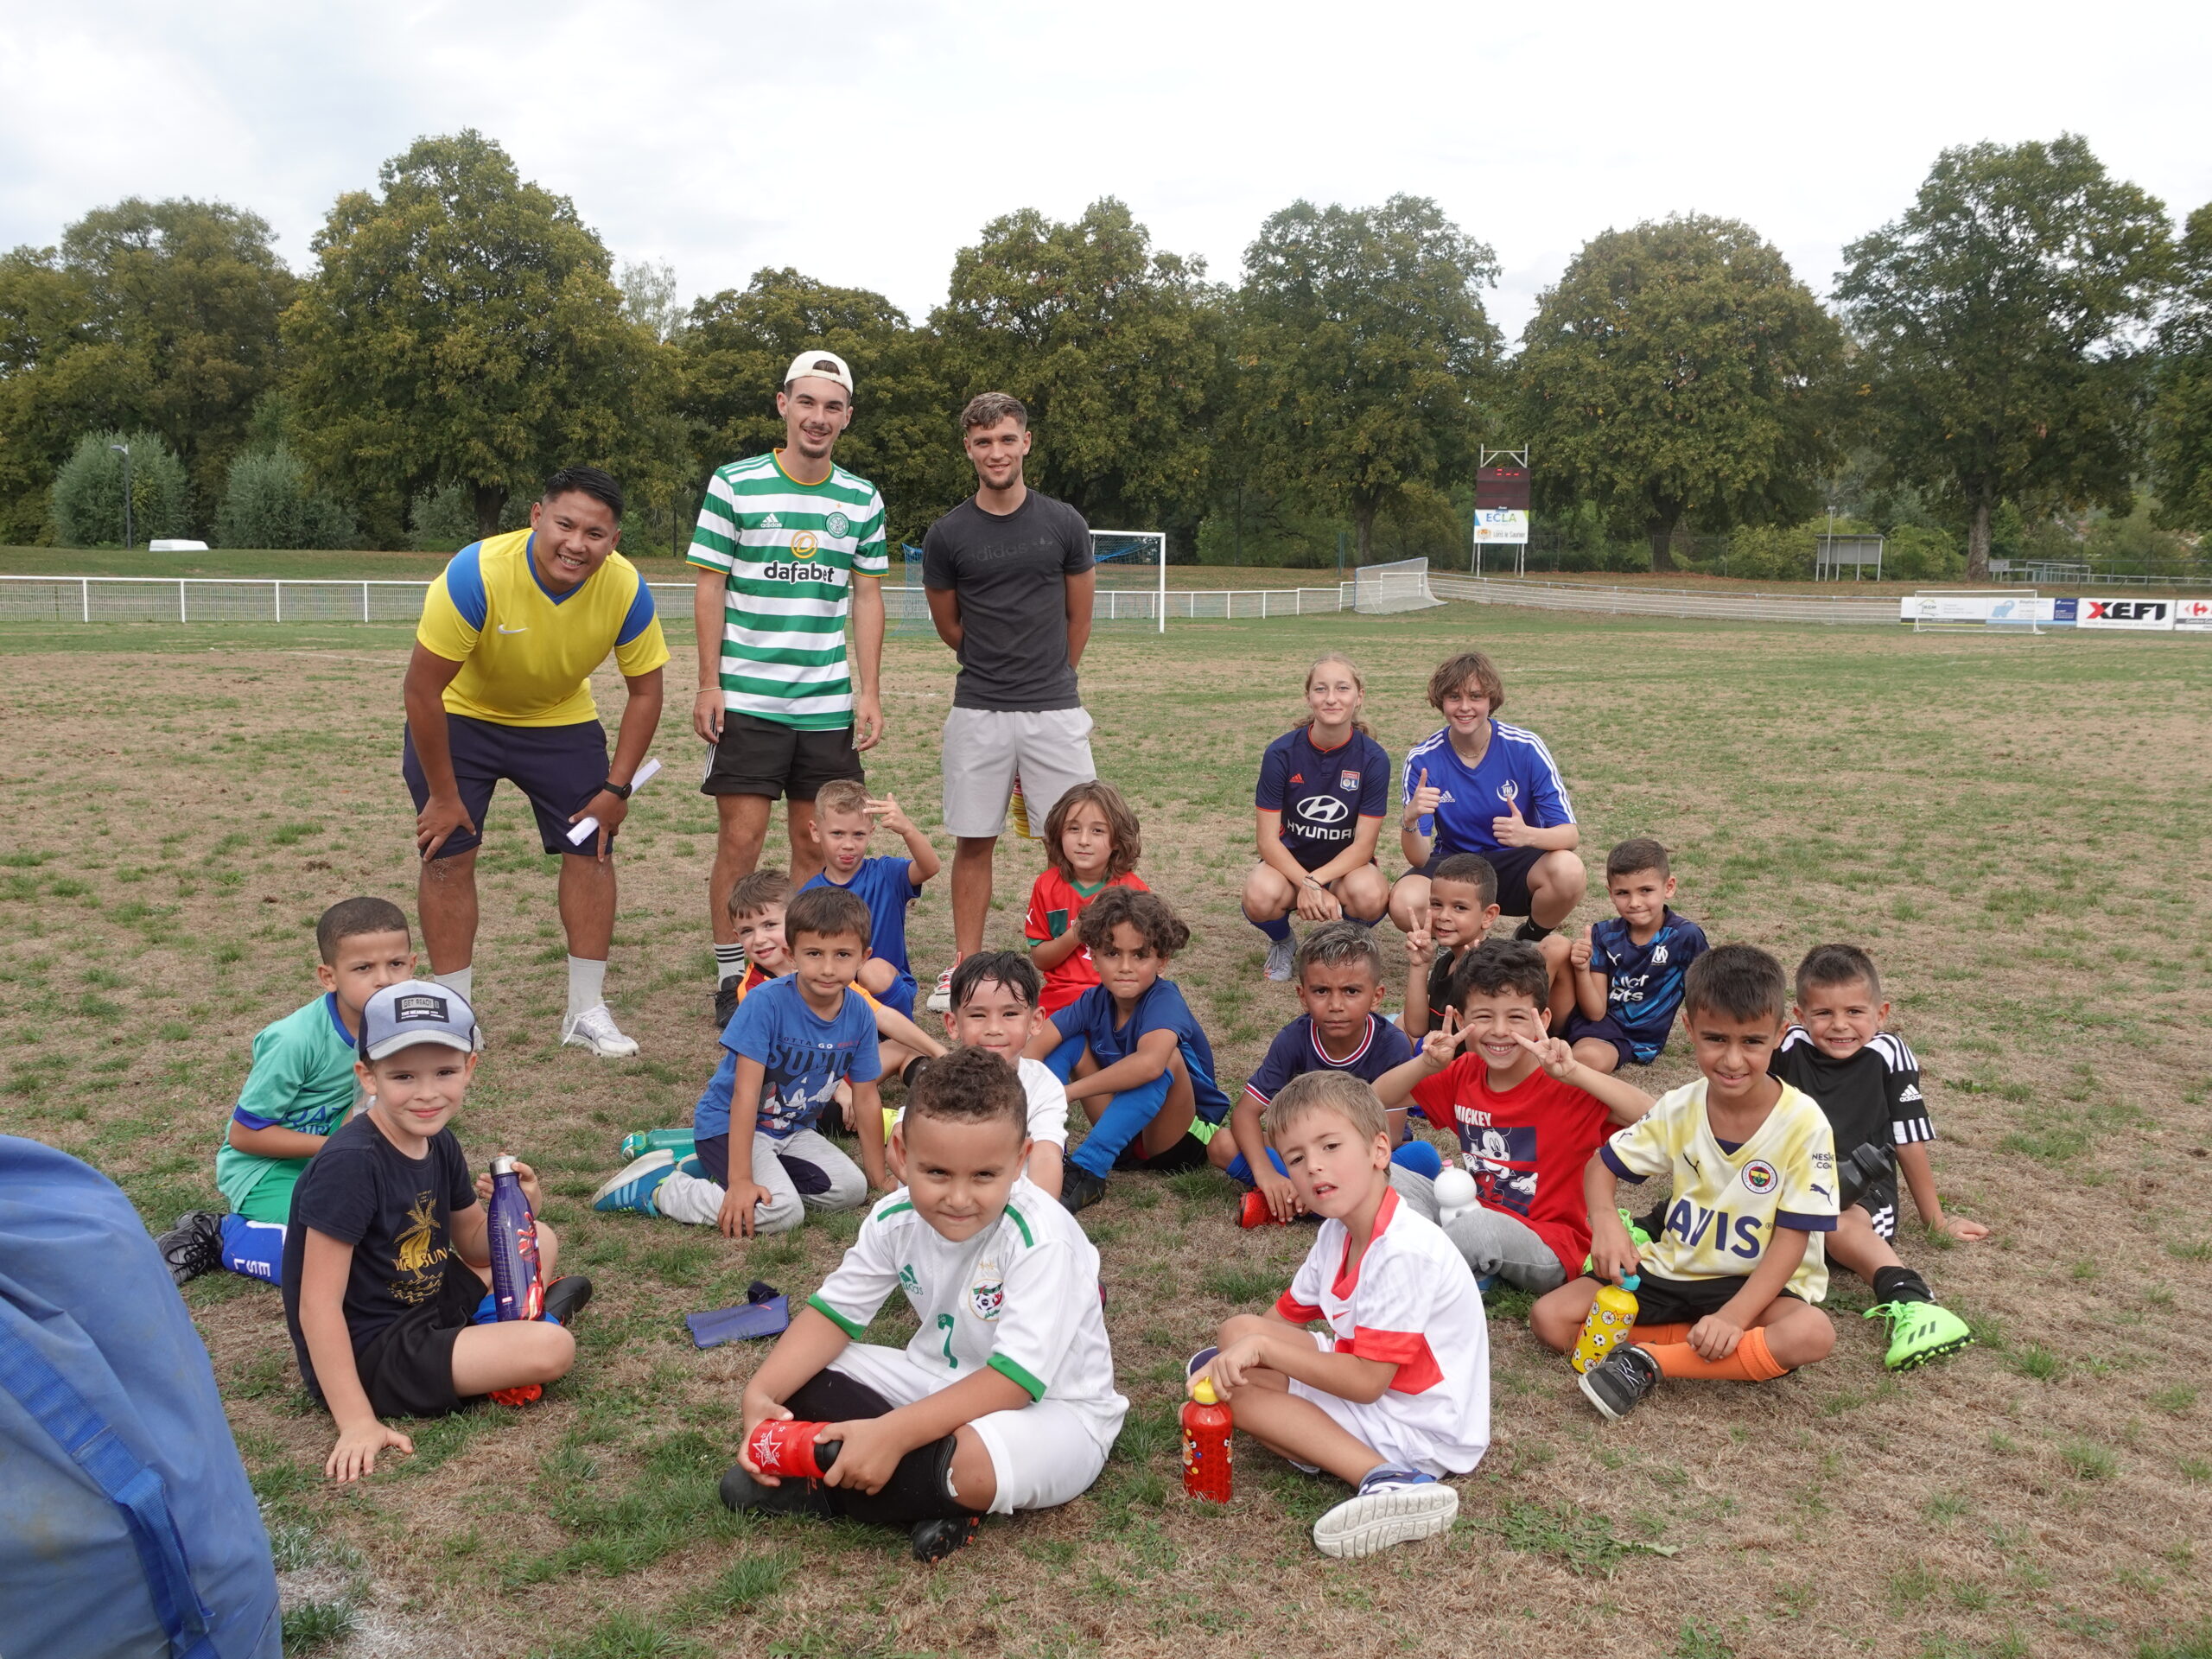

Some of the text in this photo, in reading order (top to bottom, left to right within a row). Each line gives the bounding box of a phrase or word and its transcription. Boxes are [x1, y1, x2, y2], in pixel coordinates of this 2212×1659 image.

[1486, 513, 1516, 522] ECLA
[763, 561, 835, 584] dafabet
[2087, 602, 2167, 621] XEFI
[1287, 819, 1356, 841] HYUNDA
[777, 1034, 811, 1046] OTTA
[1899, 1094, 1923, 1103] adidas
[1454, 1104, 1491, 1127] MICKEY
[1665, 1198, 1763, 1259] AVIS
[420, 1247, 448, 1268] SUN
[938, 1313, 958, 1370] 7
